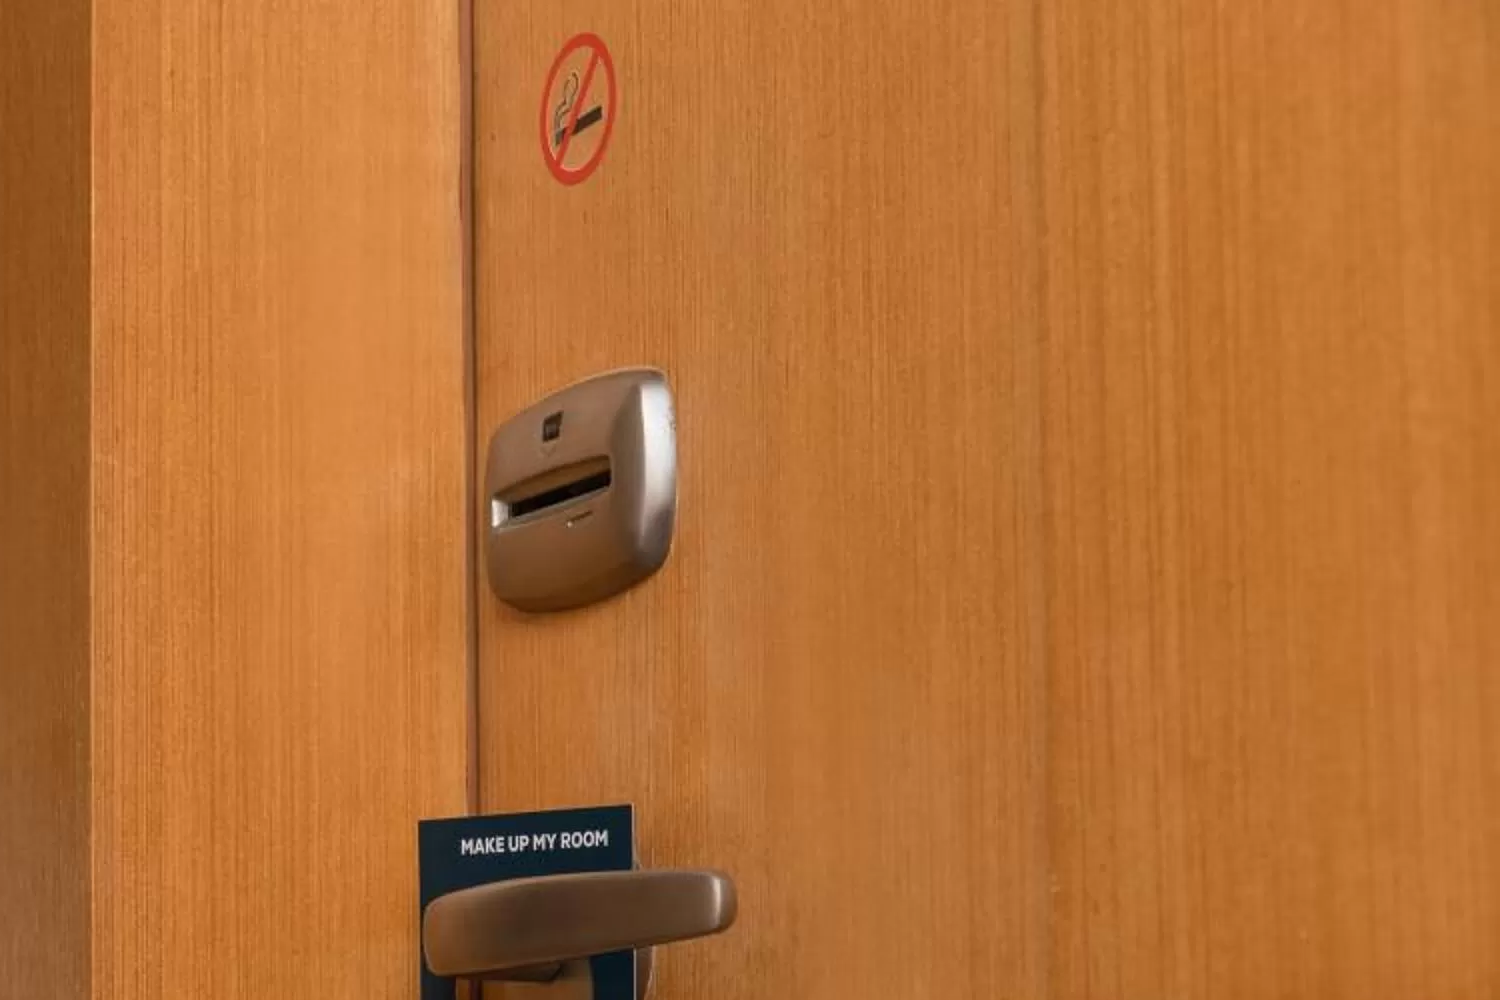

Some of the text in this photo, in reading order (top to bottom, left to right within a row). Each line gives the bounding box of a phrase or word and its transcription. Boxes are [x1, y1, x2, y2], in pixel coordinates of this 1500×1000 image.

[461, 829, 609, 856] MAKE UP MY ROOM
